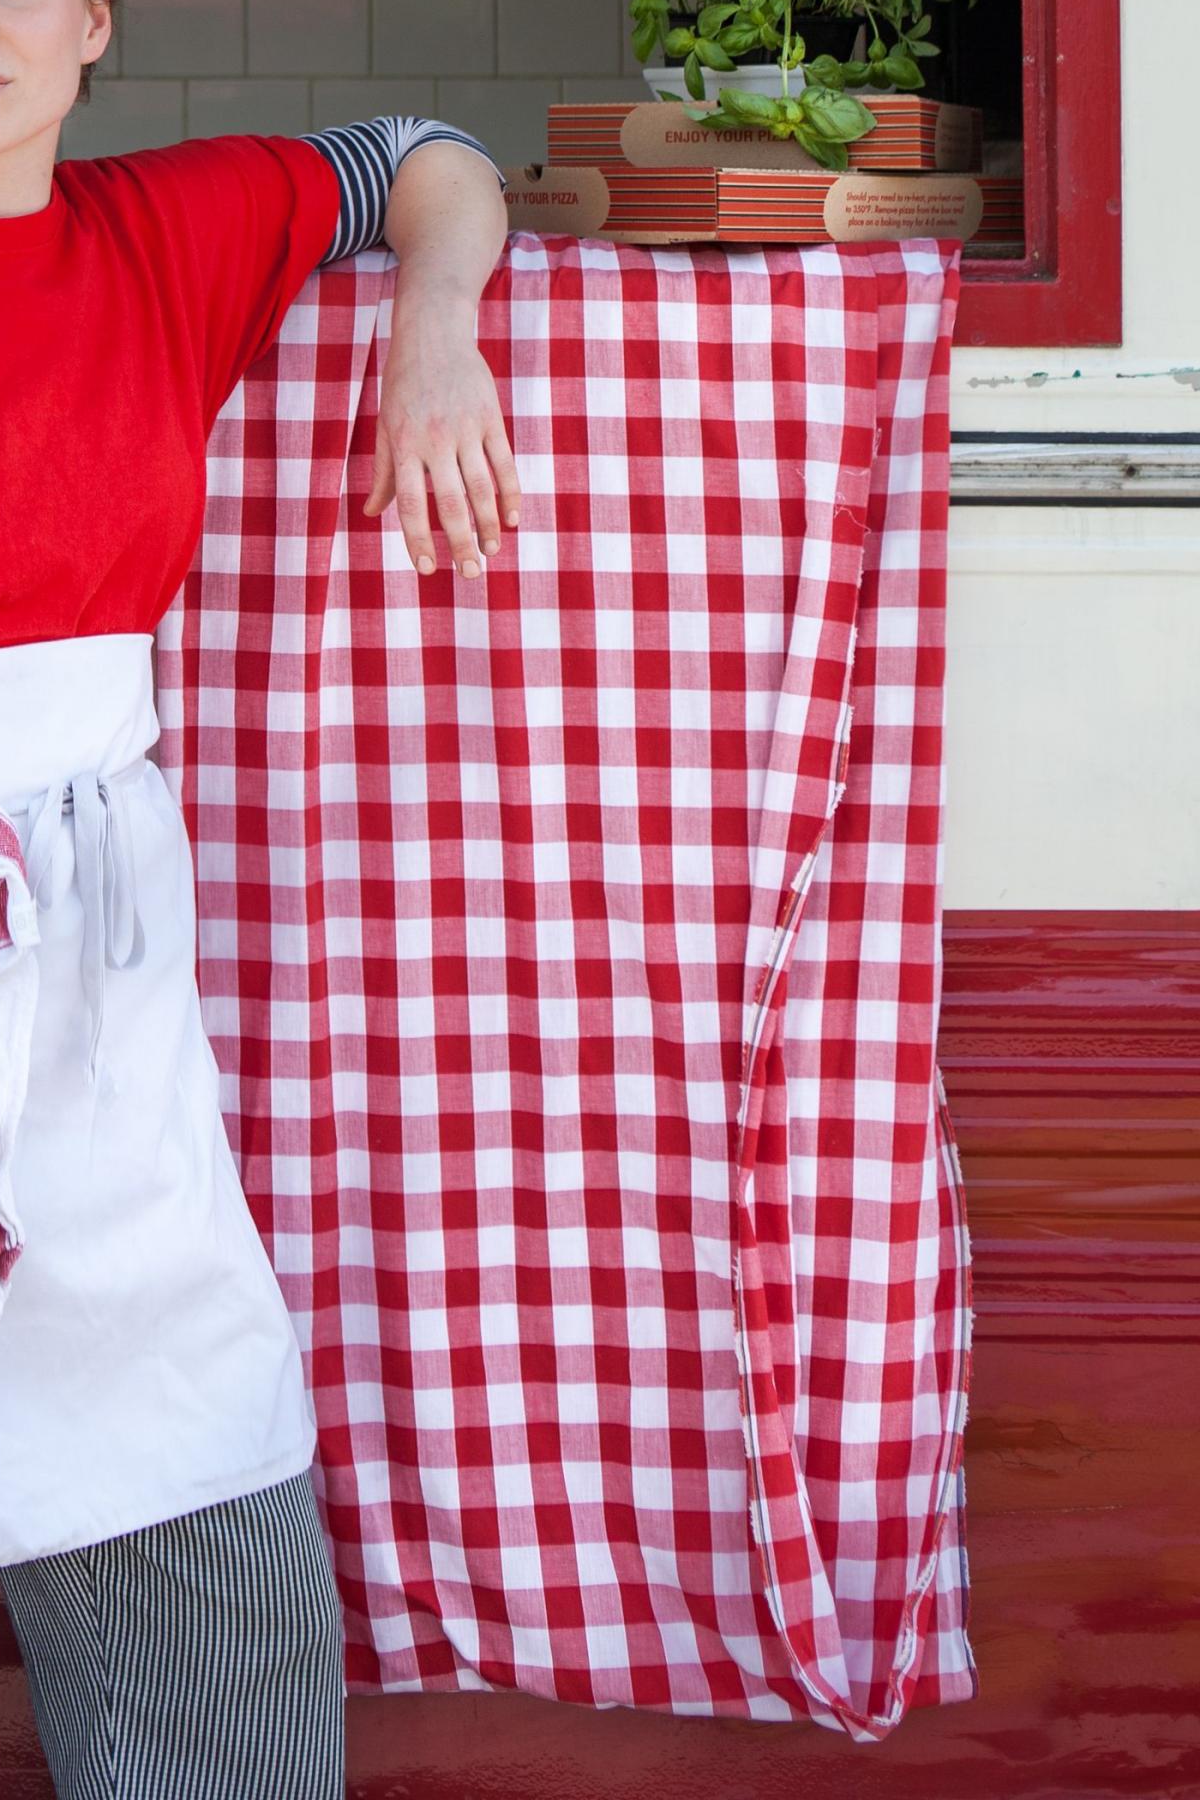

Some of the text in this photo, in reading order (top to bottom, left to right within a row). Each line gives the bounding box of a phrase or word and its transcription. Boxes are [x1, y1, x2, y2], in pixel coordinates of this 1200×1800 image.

[665, 131, 709, 143] ENJOY
[712, 131, 753, 143] YOUR
[522, 192, 549, 205] YOUR
[551, 193, 579, 205] PIZZA
[846, 192, 867, 201] Should
[868, 195, 880, 203] you
[880, 192, 897, 201] need
[874, 205, 898, 214] Remove
[898, 206, 915, 216] pizza
[917, 205, 930, 214] from
[930, 206, 940, 214] the
[848, 217, 864, 228] place
[880, 217, 901, 228] baking
[902, 218, 913, 228] tray
[915, 217, 924, 226] for
